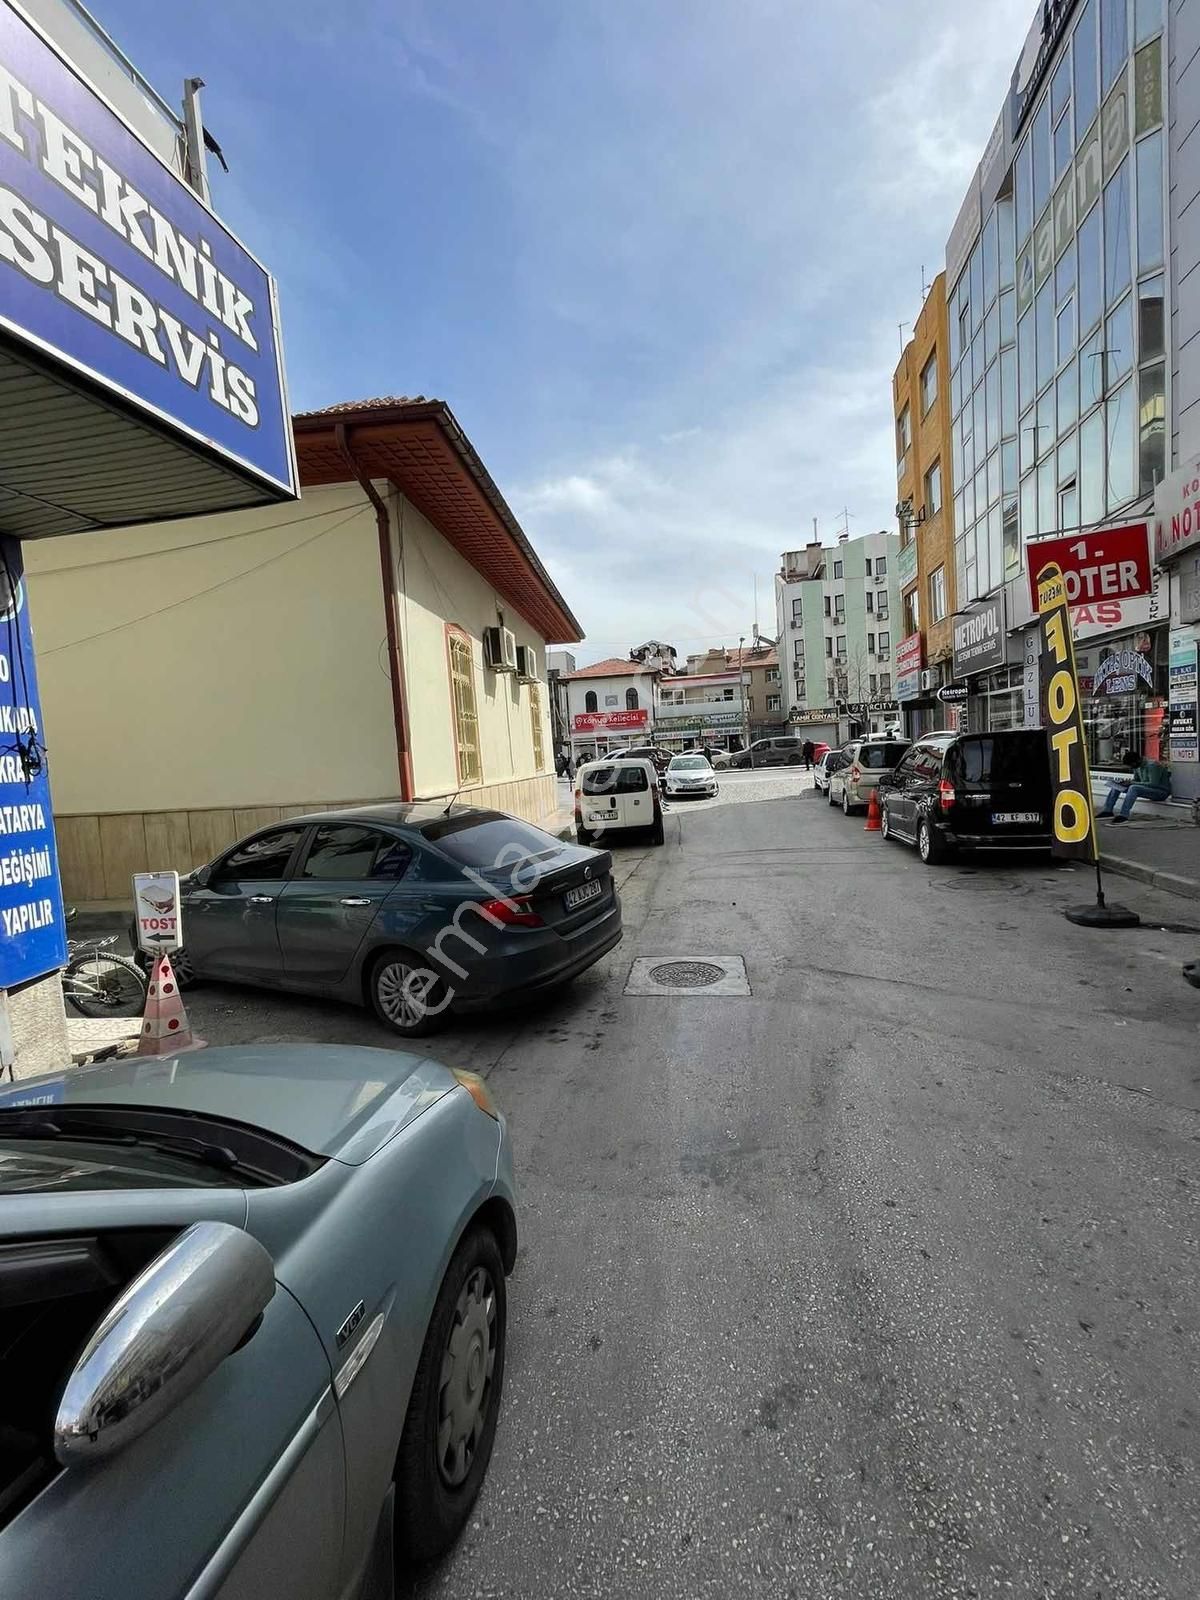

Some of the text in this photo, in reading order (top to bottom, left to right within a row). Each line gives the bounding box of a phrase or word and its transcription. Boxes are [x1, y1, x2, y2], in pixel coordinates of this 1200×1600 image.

[0, 65, 259, 352] TEKNİK
[0, 188, 259, 427] SERVİS
[1063, 560, 1141, 601] OTER
[955, 606, 999, 652] METROPOL
[1106, 675, 1136, 694] LENS
[2, 898, 54, 937] YAPILIR
[141, 917, 177, 930] TOST
